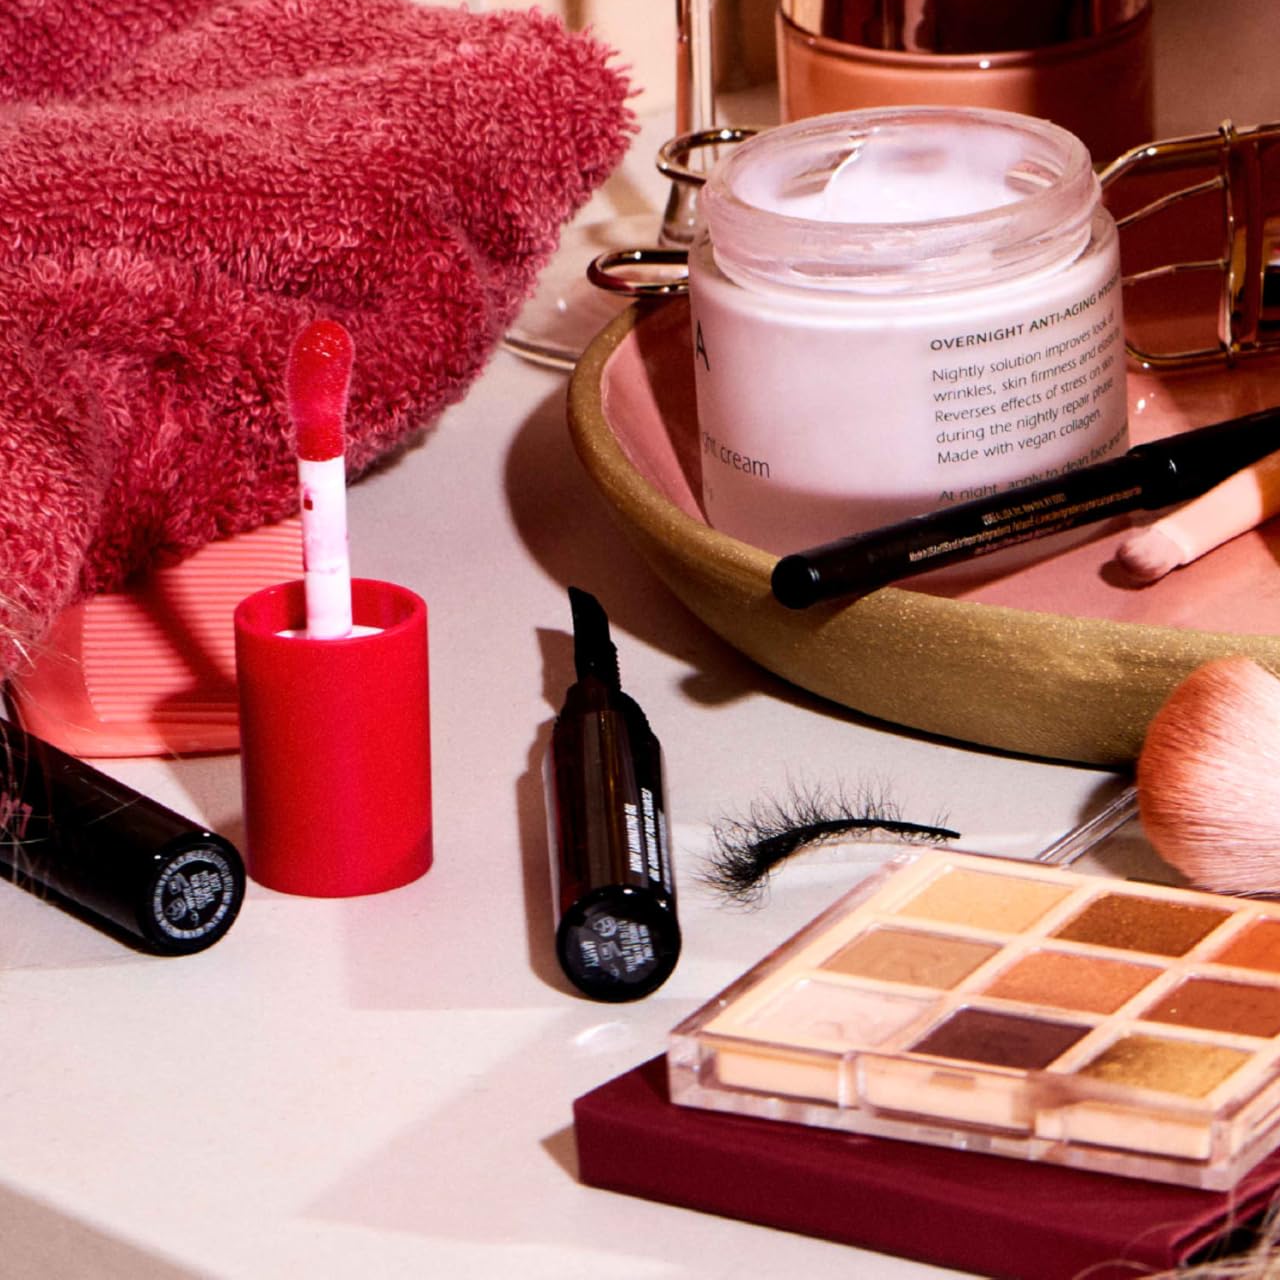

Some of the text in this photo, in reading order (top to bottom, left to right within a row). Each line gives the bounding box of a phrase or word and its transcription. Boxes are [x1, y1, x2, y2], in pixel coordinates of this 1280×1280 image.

[930, 323, 1025, 351] OVERNIGHT
[1029, 293, 1097, 332] ANTI-AGING
[932, 364, 985, 384] Nightly
[990, 351, 1042, 373] solution
[1045, 329, 1091, 358] improves
[1092, 314, 1107, 335] look
[1002, 375, 1028, 392] skin
[1031, 357, 1078, 384] firmness
[1079, 345, 1097, 366] and
[935, 403, 997, 423] Reverses
[1001, 392, 1043, 413] effects
[1045, 383, 1059, 401] of
[1060, 373, 1088, 394] stress
[1089, 365, 1101, 381] on
[936, 426, 986, 444] during
[990, 422, 1013, 437] the
[1017, 406, 1060, 430] nightly
[1062, 392, 1090, 415] repair
[720, 442, 770, 479] cream
[938, 447, 980, 464] Made
[983, 440, 1015, 459] with
[1017, 428, 1057, 450] vegan
[940, 489, 955, 501] At
